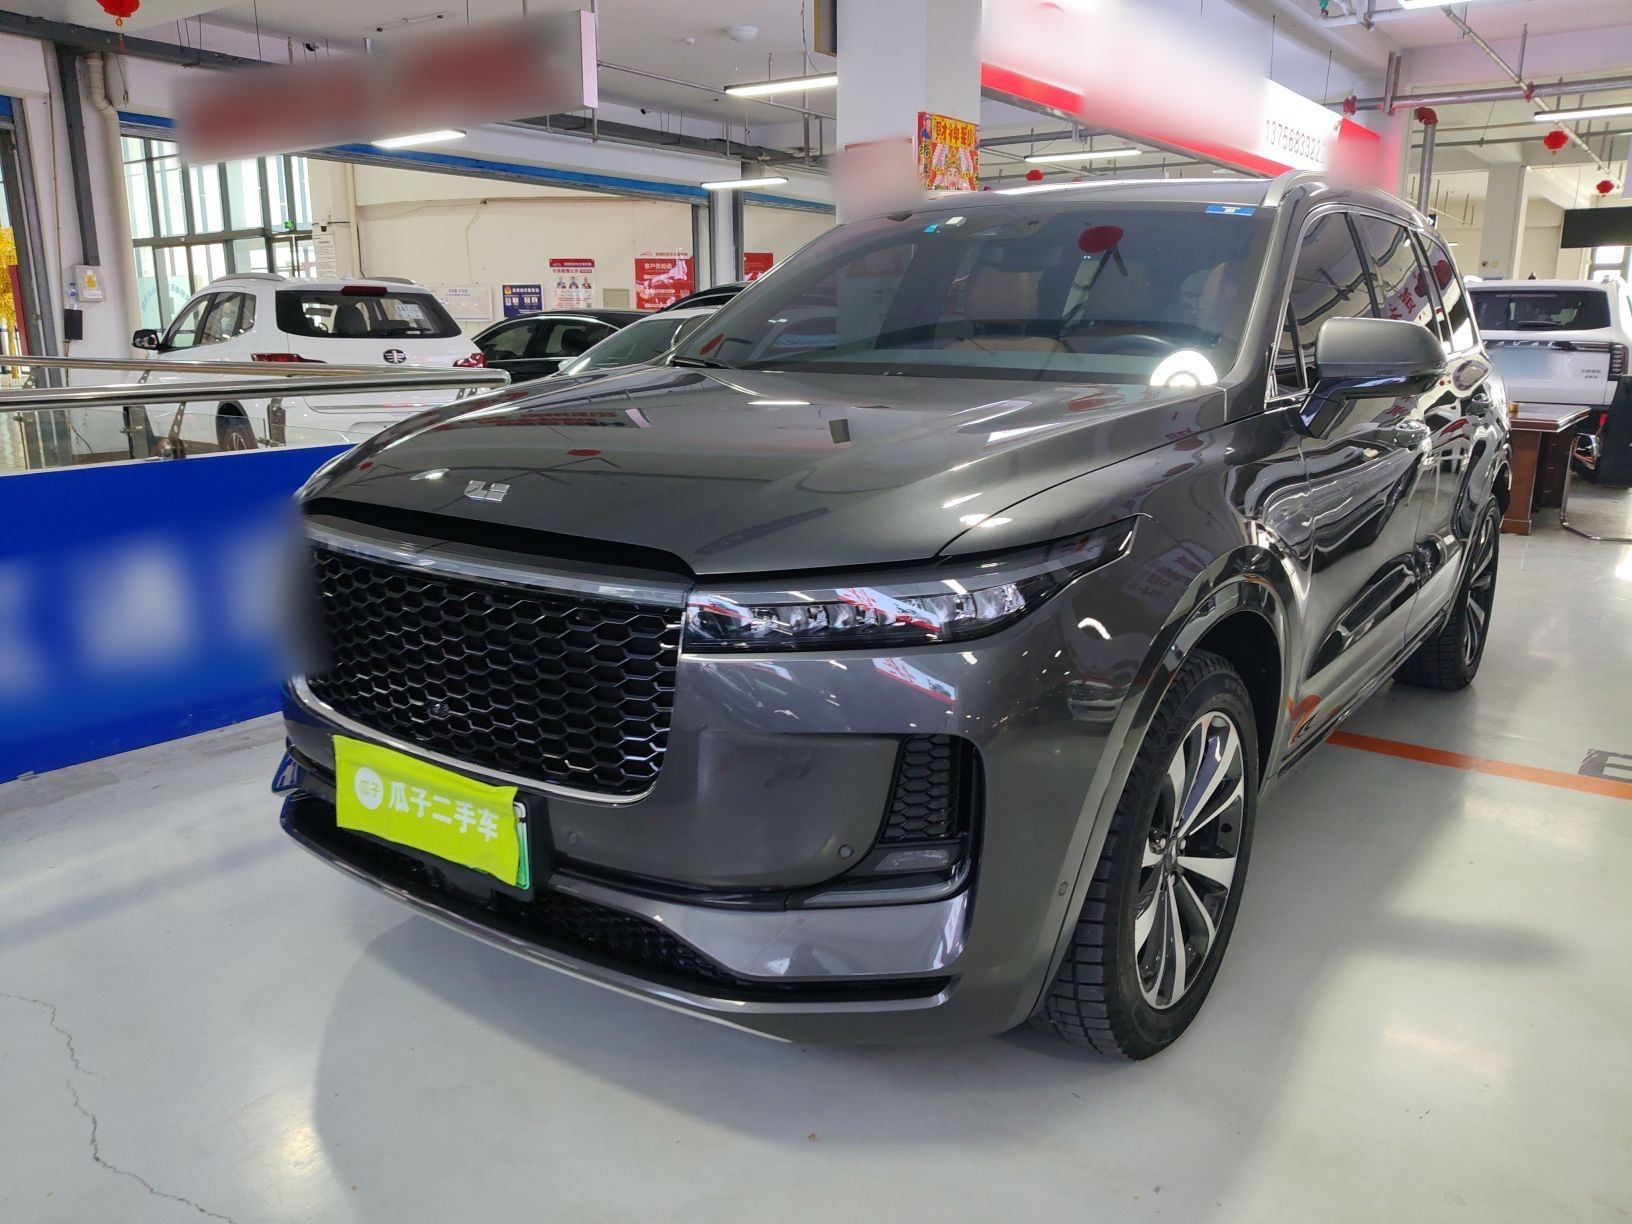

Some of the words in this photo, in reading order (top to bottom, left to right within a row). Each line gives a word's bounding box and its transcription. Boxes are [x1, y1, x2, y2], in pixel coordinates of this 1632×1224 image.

[388, 781, 498, 842] 瓜子二手车
